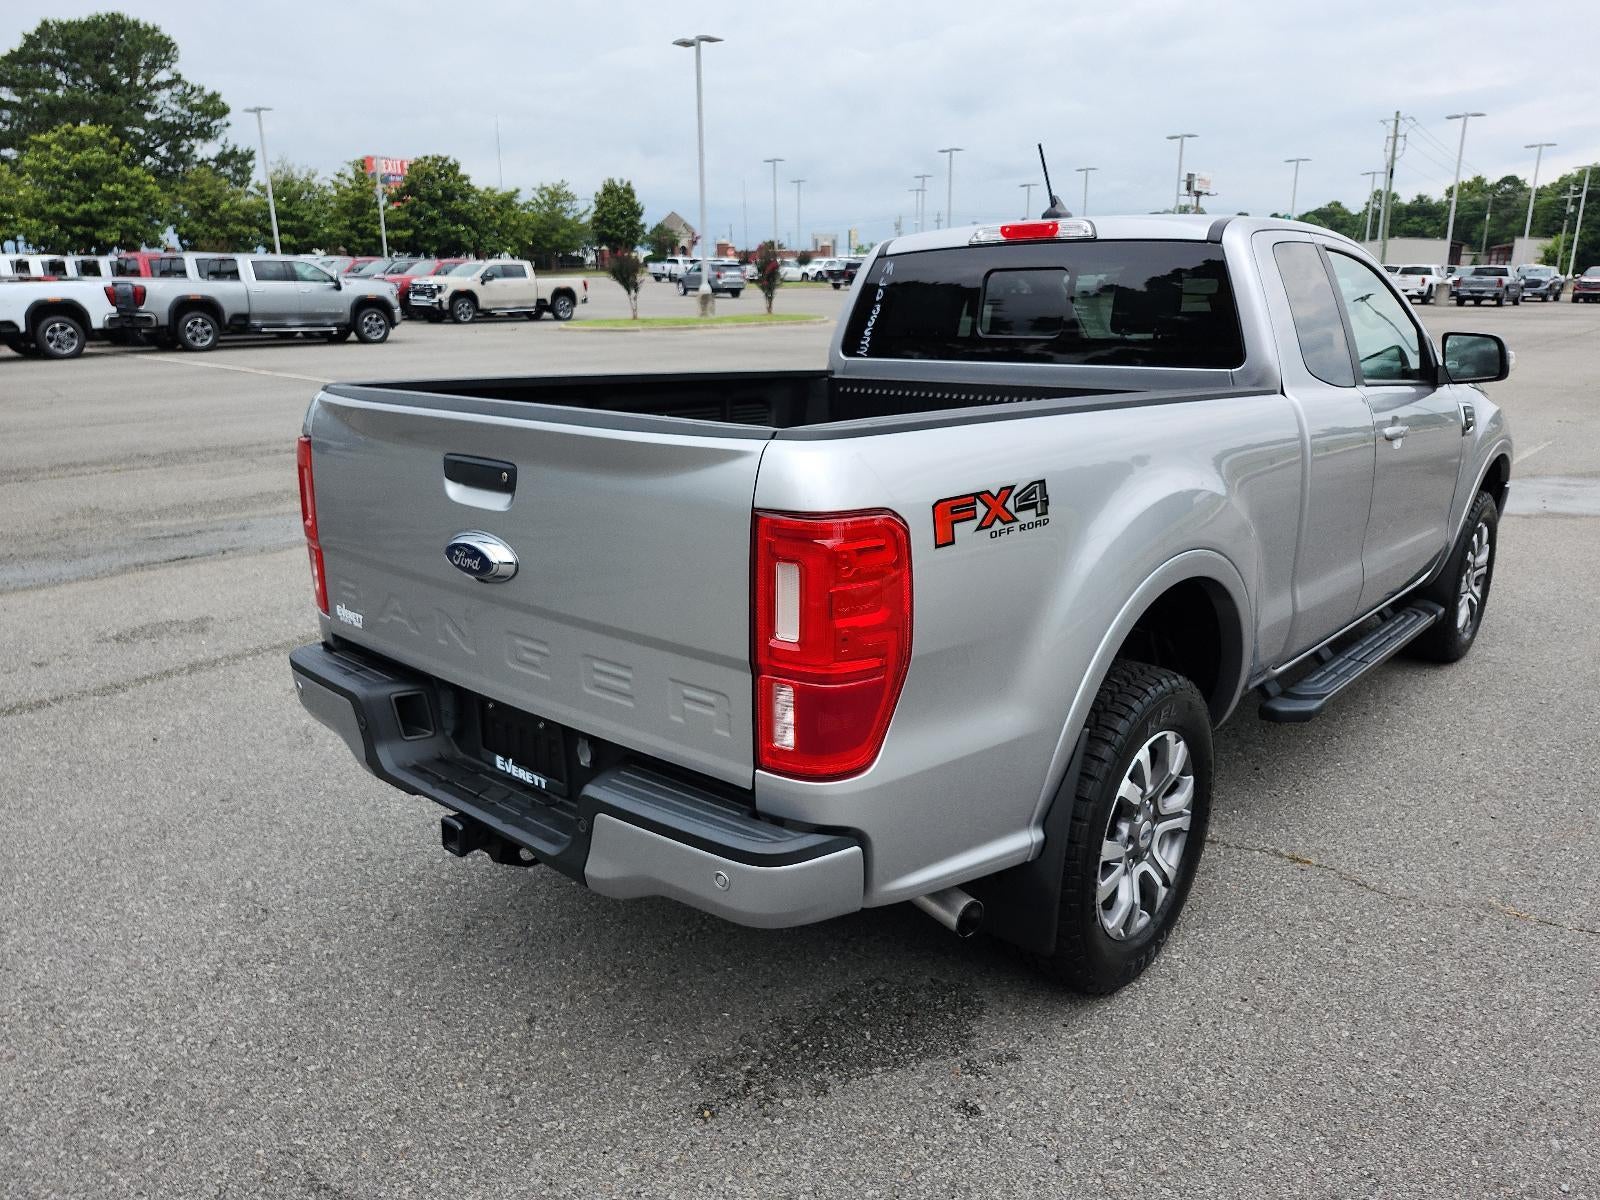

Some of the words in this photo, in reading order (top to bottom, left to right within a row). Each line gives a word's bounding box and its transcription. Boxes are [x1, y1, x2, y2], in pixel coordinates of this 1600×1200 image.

[932, 478, 1050, 549] FX4
[989, 525, 1015, 539] OFF
[1019, 517, 1050, 532] ROAD
[452, 549, 481, 571] Ford
